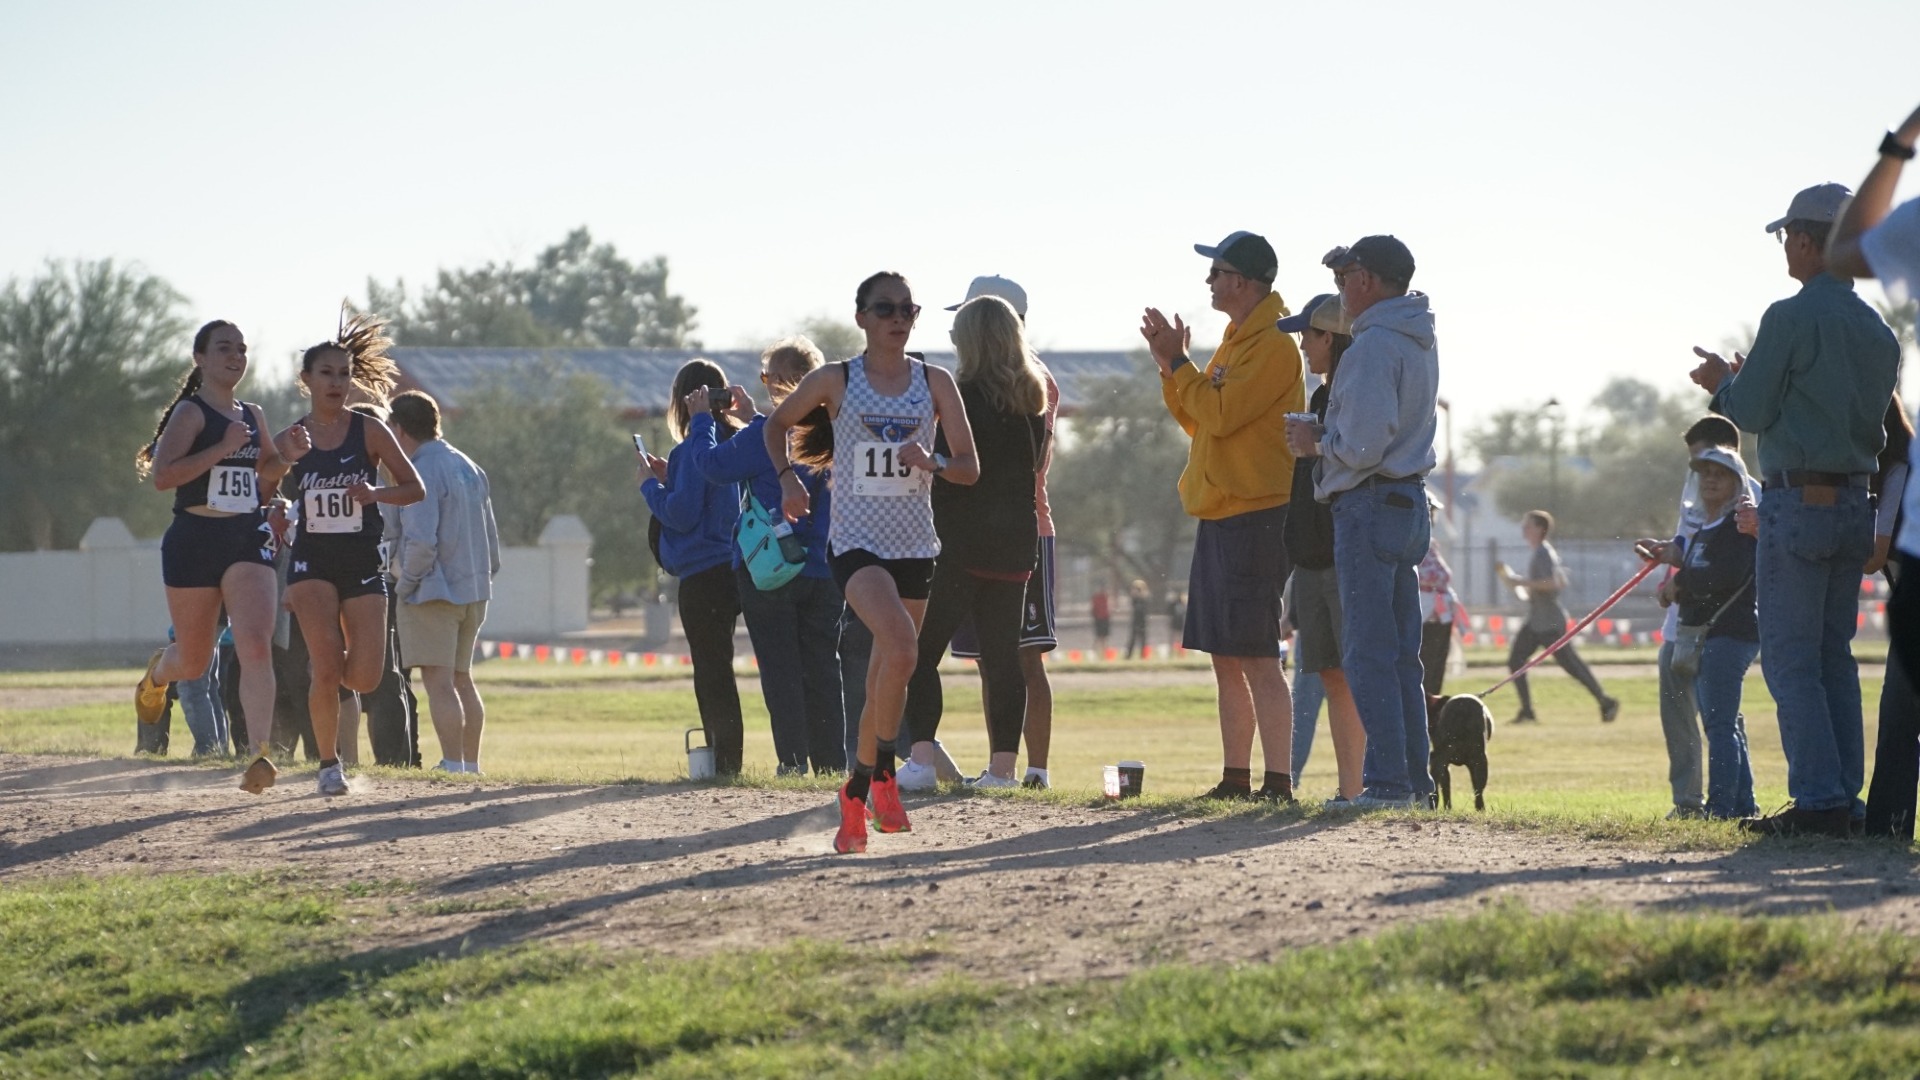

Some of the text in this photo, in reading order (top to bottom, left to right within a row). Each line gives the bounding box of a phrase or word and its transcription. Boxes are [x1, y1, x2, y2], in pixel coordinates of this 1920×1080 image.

[218, 470, 252, 497] 159
[297, 469, 369, 490] Master's
[314, 492, 354, 518] 160
[294, 561, 308, 573] M
